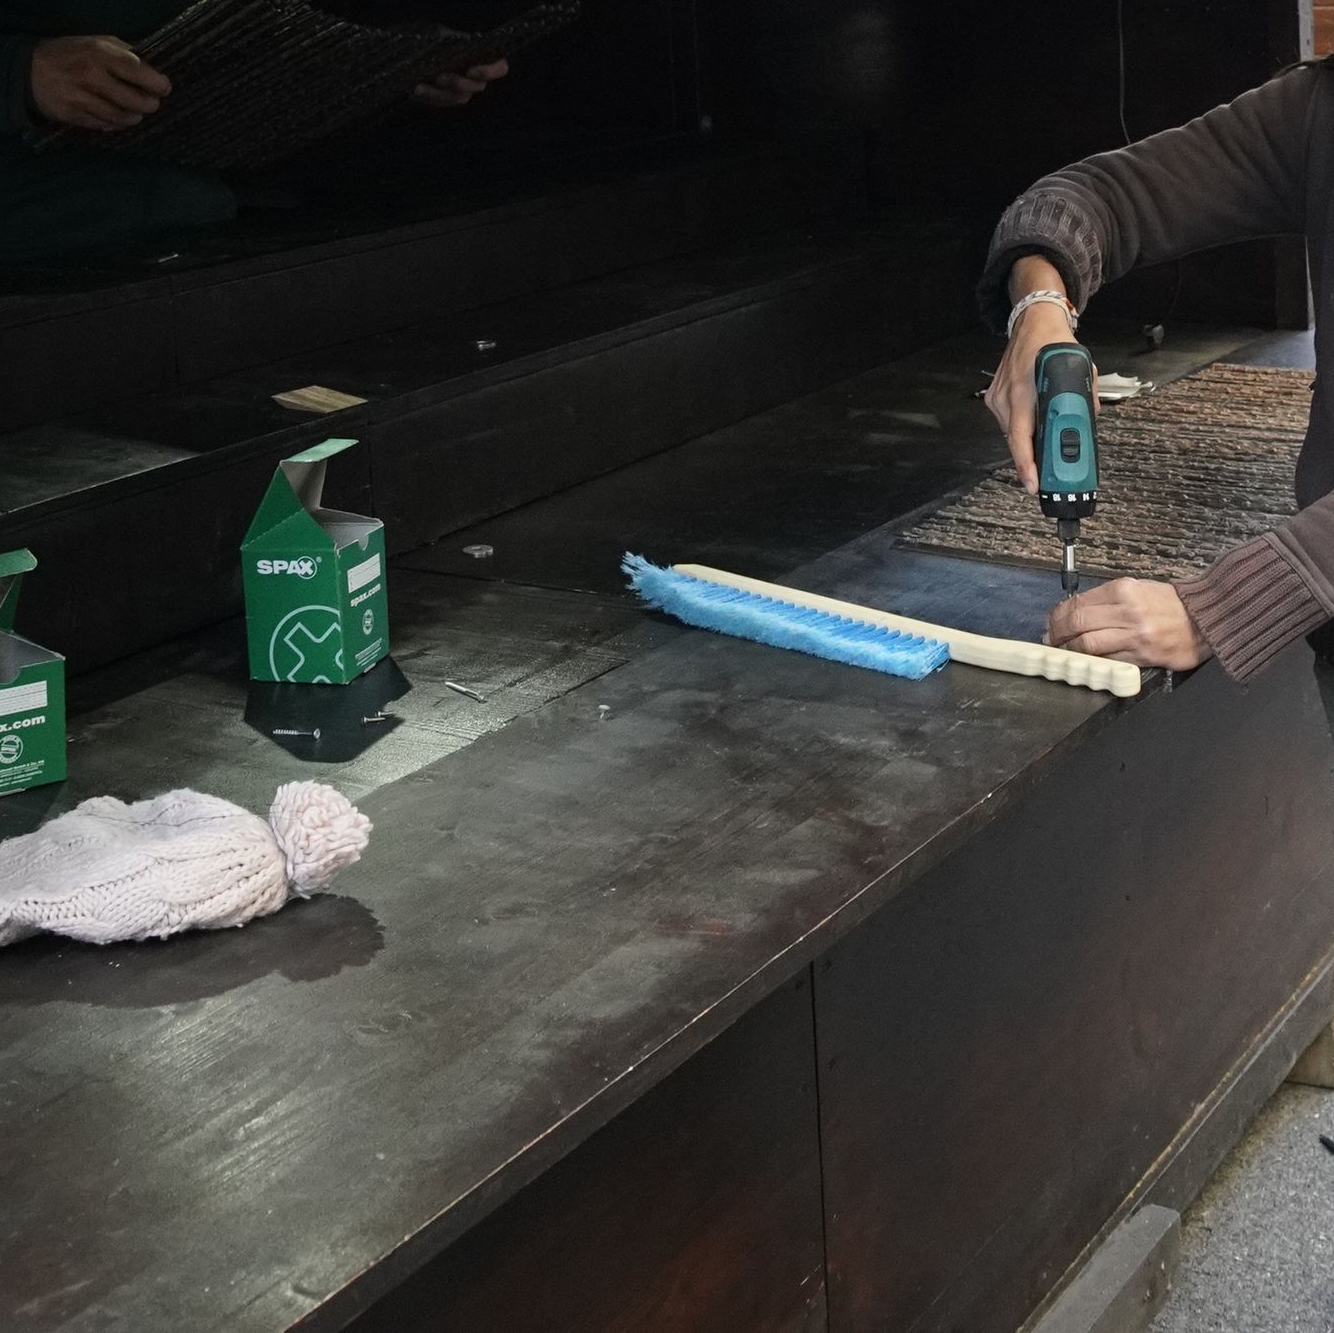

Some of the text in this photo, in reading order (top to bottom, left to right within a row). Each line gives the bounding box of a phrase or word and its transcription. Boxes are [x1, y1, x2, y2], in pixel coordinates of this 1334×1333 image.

[1052, 493, 1062, 502] 18
[1067, 493, 1077, 502] 16
[256, 556, 317, 579] SPAX
[350, 583, 381, 607] spax.com
